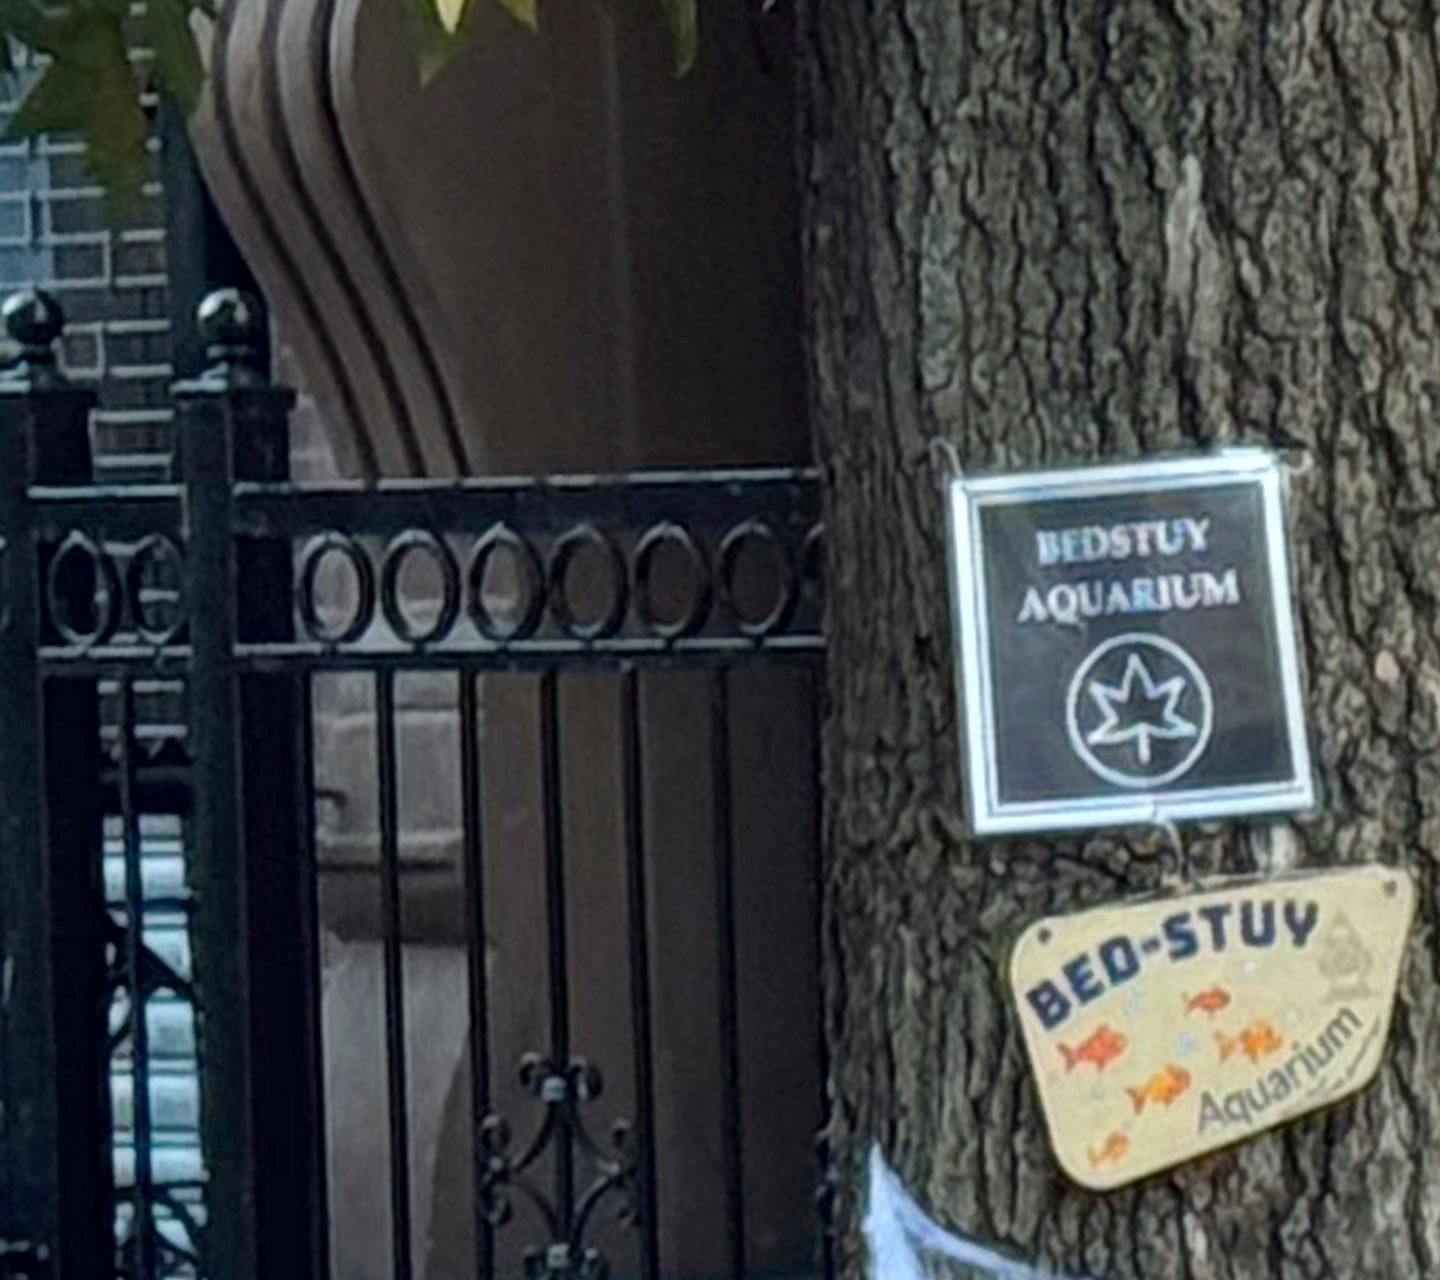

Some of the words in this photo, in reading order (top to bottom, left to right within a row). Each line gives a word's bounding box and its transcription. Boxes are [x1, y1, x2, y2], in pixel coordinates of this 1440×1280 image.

[1036, 516, 1210, 567] BEDSTUY
[1016, 567, 1241, 626] AQUARIUM
[1025, 899, 1319, 1031] BED-STUY
[1197, 1005, 1363, 1134] Aquarium
